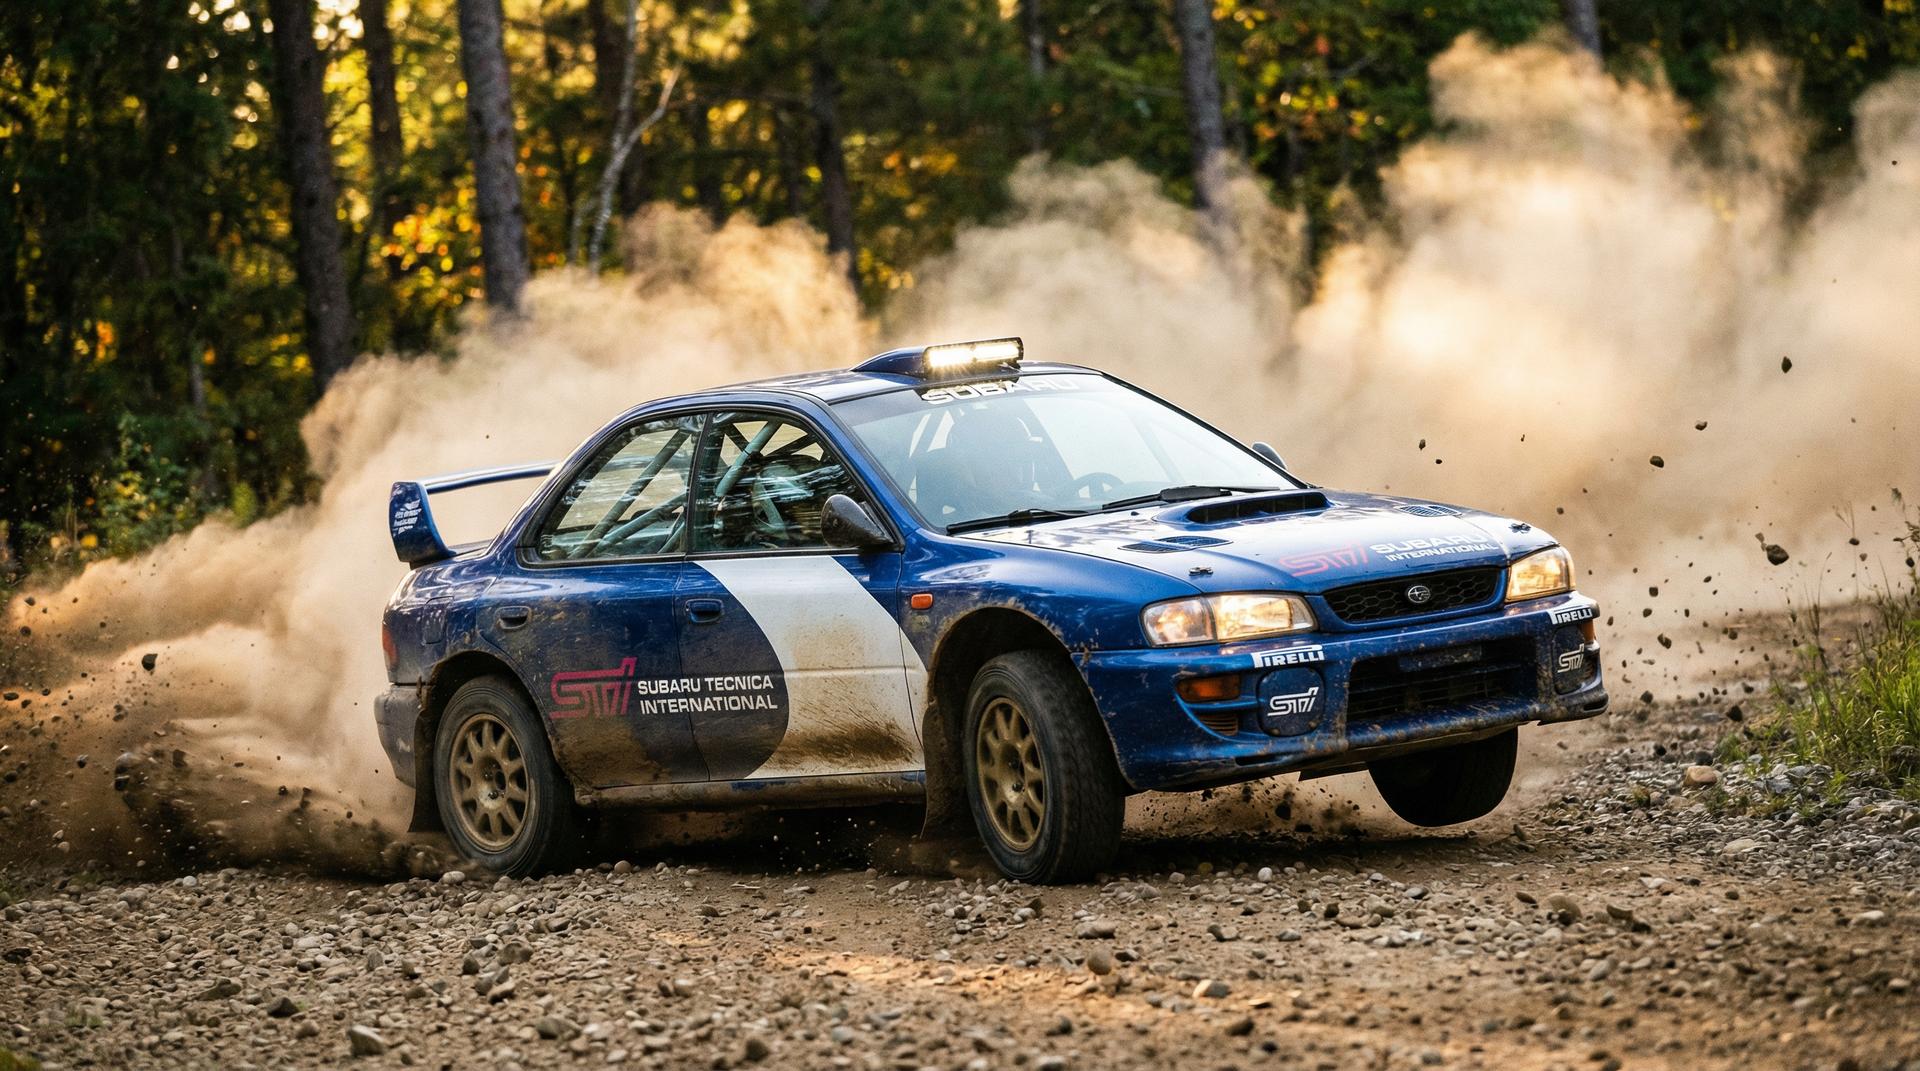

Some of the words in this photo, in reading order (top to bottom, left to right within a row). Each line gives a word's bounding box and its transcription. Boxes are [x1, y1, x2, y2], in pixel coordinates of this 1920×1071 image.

[921, 377, 1080, 405] SUBARU
[1370, 535, 1489, 554] SUBARU
[1385, 542, 1499, 562] INTERNATIONAL
[1546, 604, 1593, 625] PIRELLI
[1251, 644, 1325, 669] PIRELLI
[637, 678, 701, 696] SUBARU
[704, 675, 774, 692] TECNICA
[640, 695, 778, 715] INTERNATIONAL
